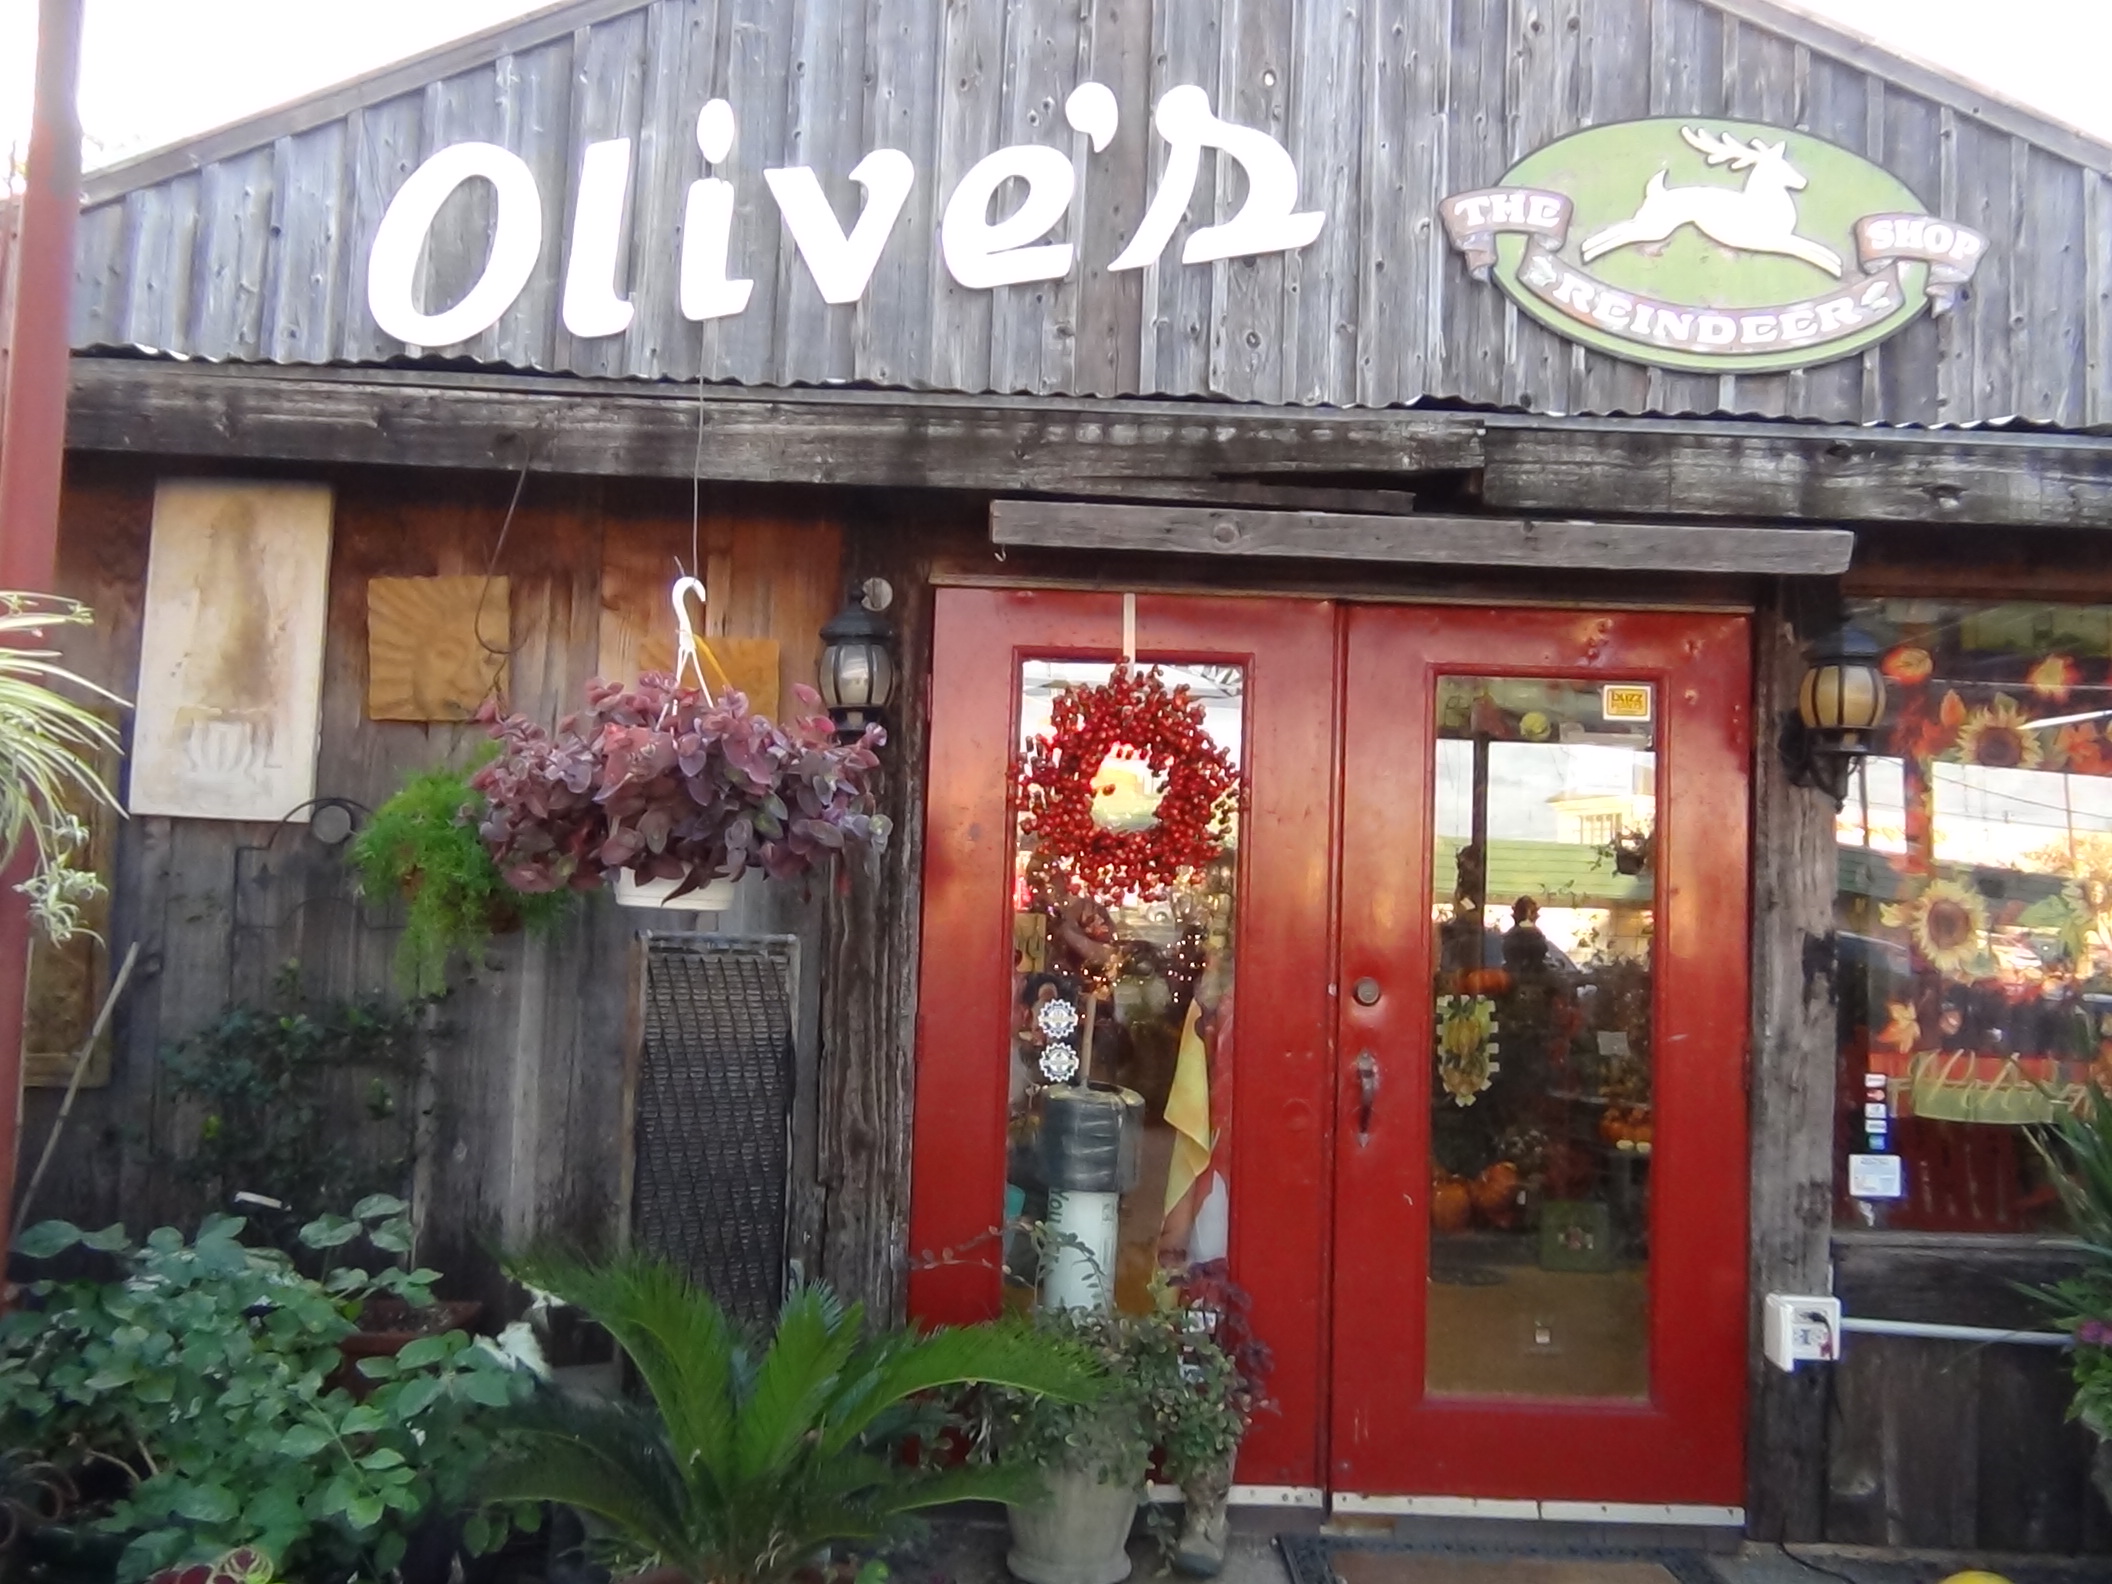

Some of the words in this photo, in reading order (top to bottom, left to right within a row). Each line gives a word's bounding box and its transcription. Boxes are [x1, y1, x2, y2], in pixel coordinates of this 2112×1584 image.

[367, 81, 1327, 347] Olive's
[1454, 193, 1562, 228] THE
[1551, 271, 1864, 344] REINDEER
[1868, 218, 1982, 261] SHOP
